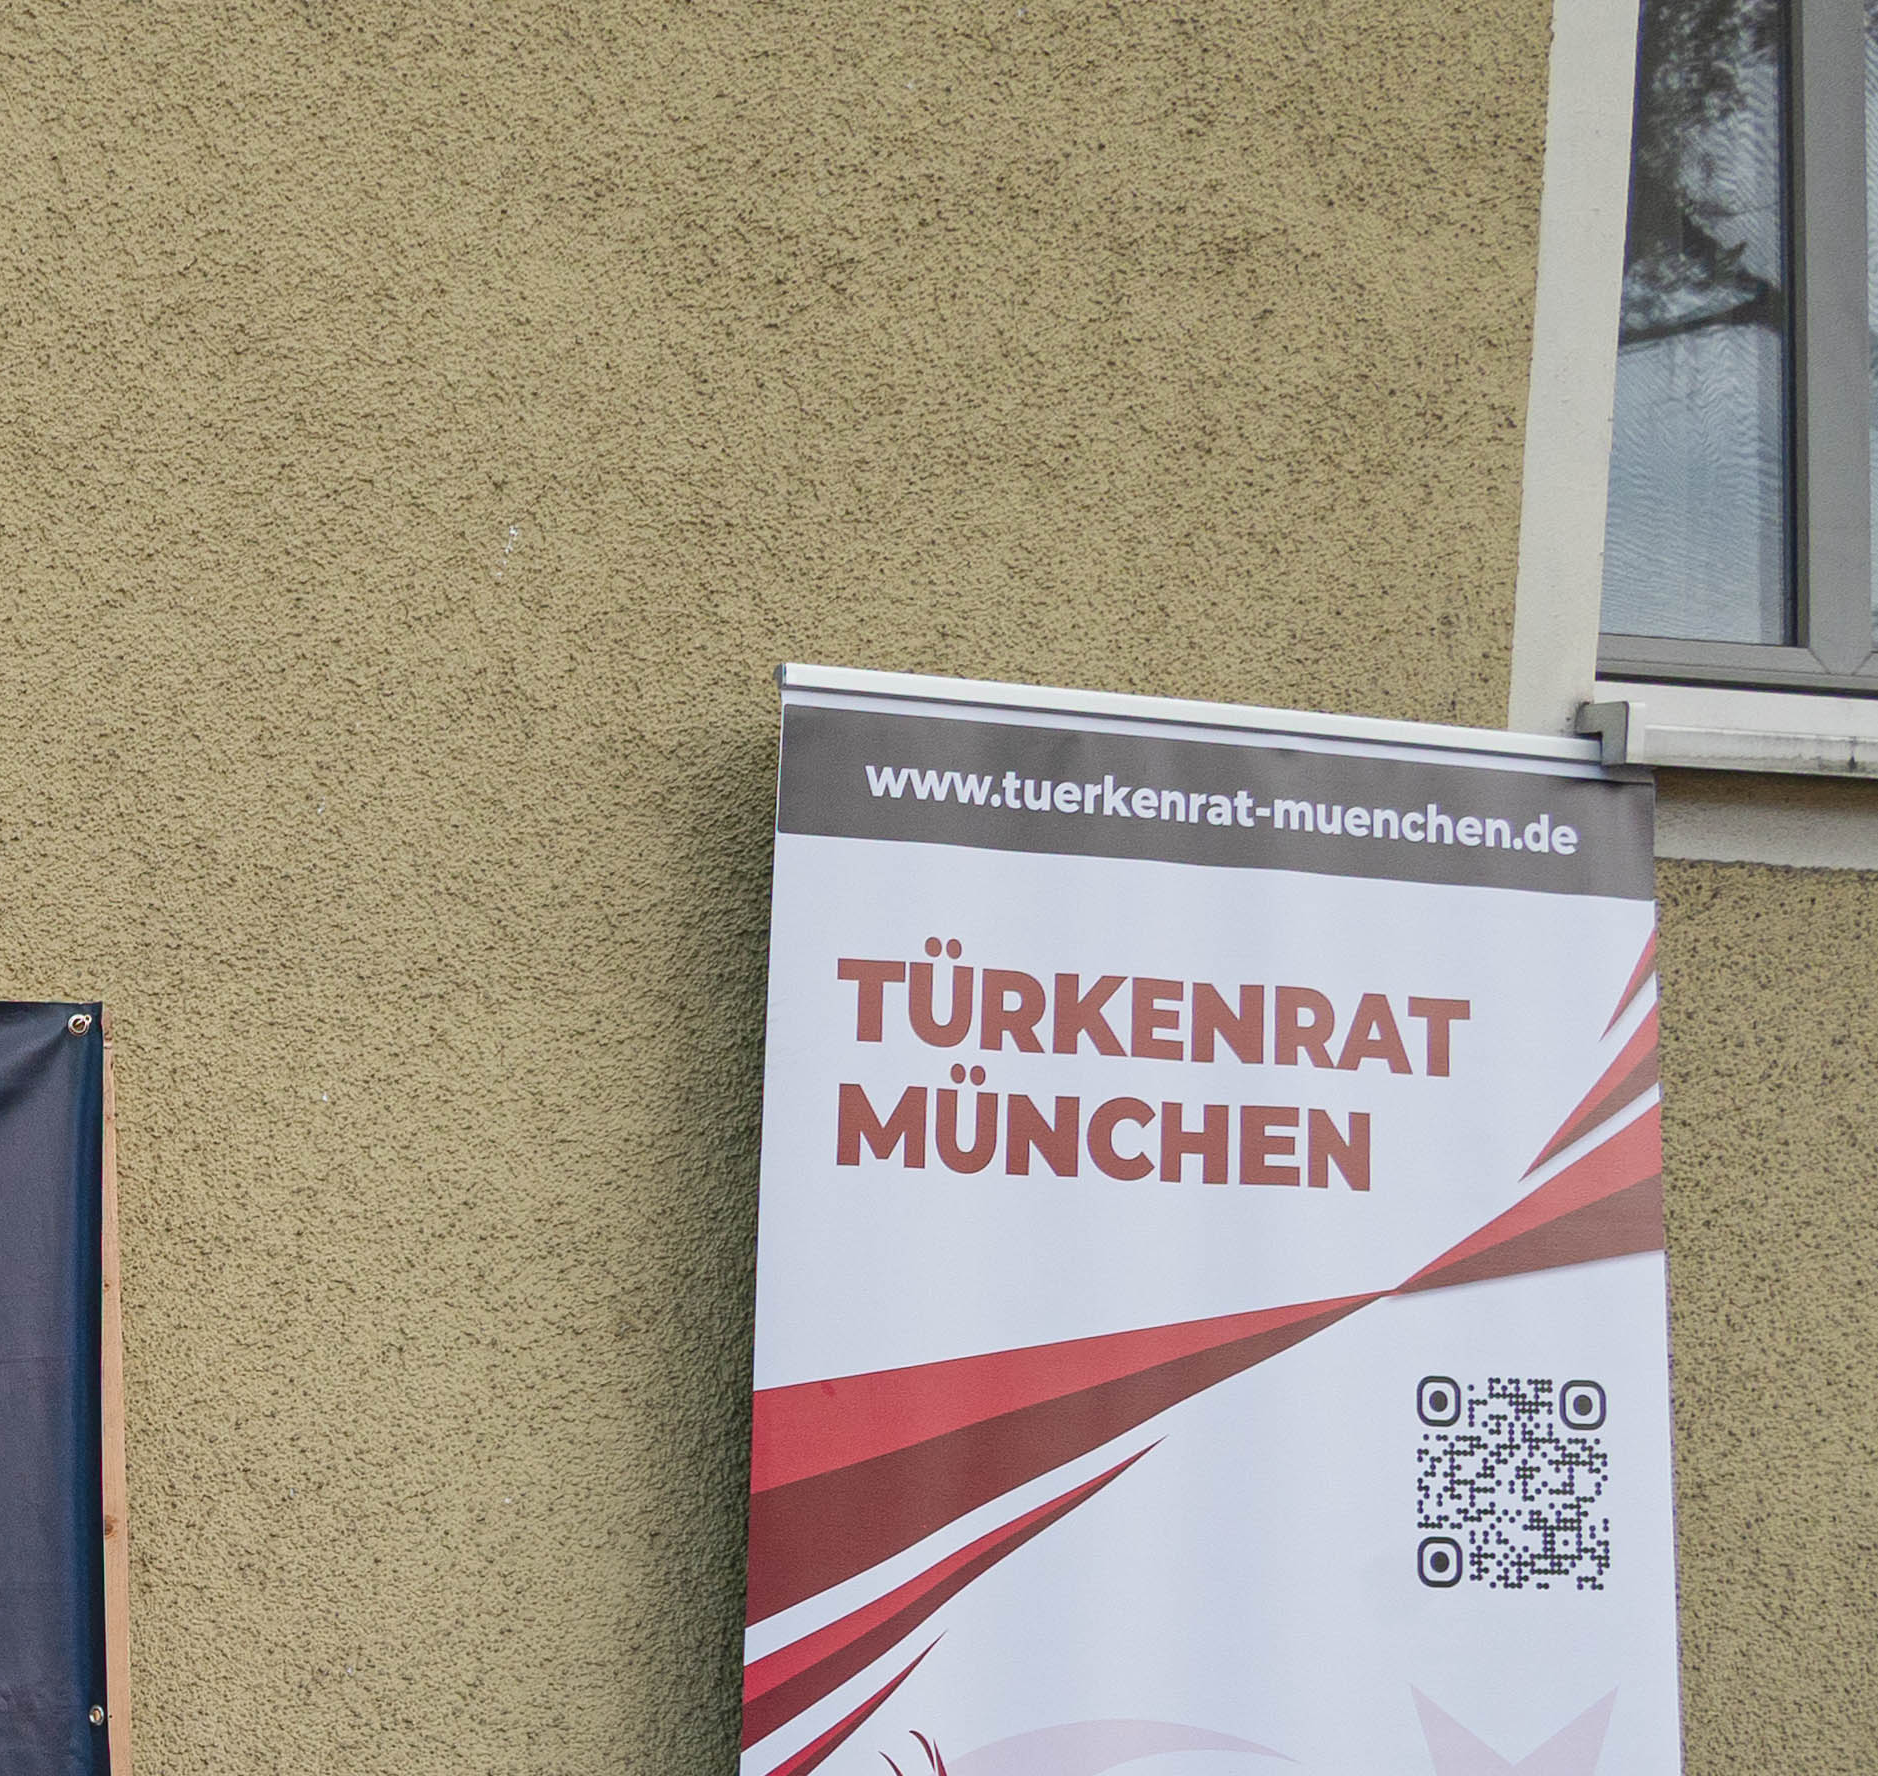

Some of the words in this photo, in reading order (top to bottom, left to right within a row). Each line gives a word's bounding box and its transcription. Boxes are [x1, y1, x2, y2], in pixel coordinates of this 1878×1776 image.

[866, 764, 1578, 854] www.tuerkenrat-muenchen.de
[837, 937, 1470, 1077] TÜRKENRAT
[837, 1064, 1370, 1191] MÜNCHEN
